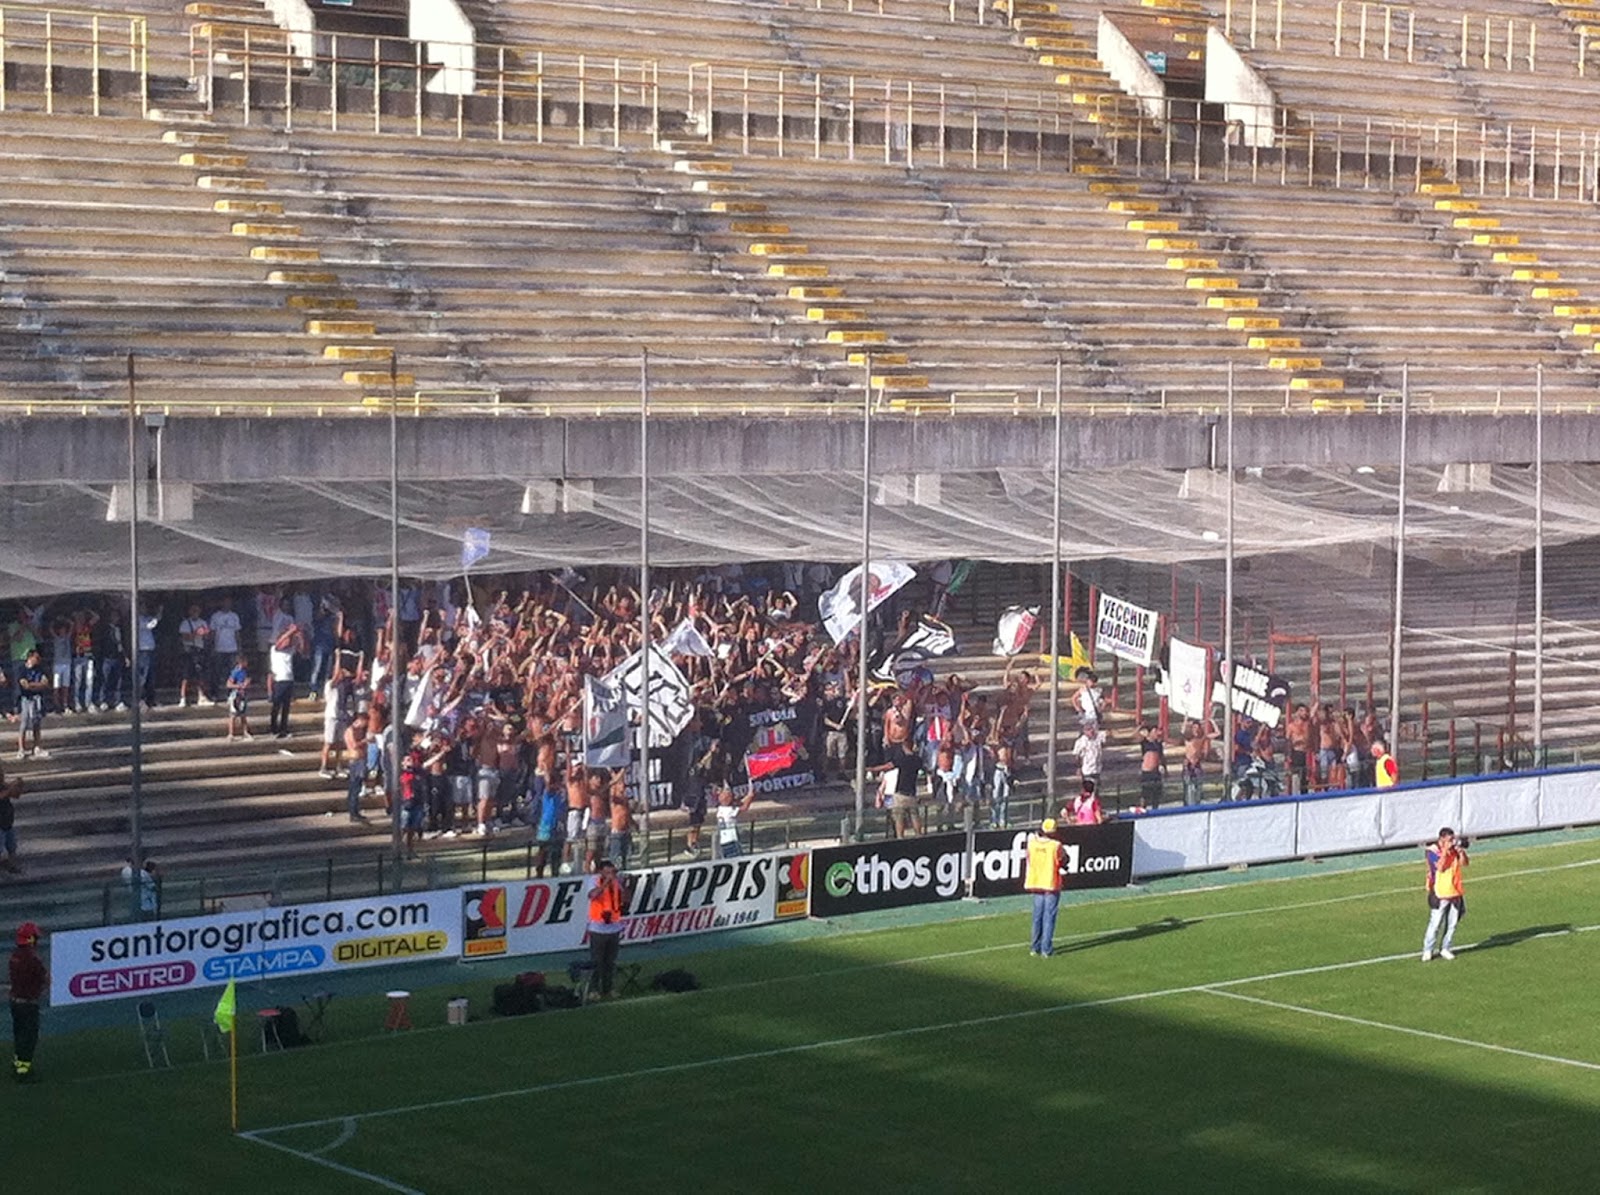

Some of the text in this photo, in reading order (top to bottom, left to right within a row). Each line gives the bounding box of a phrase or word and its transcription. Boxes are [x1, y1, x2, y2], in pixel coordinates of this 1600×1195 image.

[1103, 599, 1149, 631] VECCHIA
[512, 880, 584, 928] DE
[91, 902, 429, 962] santorografica.com
[80, 964, 186, 994] CENTRO
[210, 948, 317, 978] STAMPA
[338, 934, 442, 962] DIGITALE
